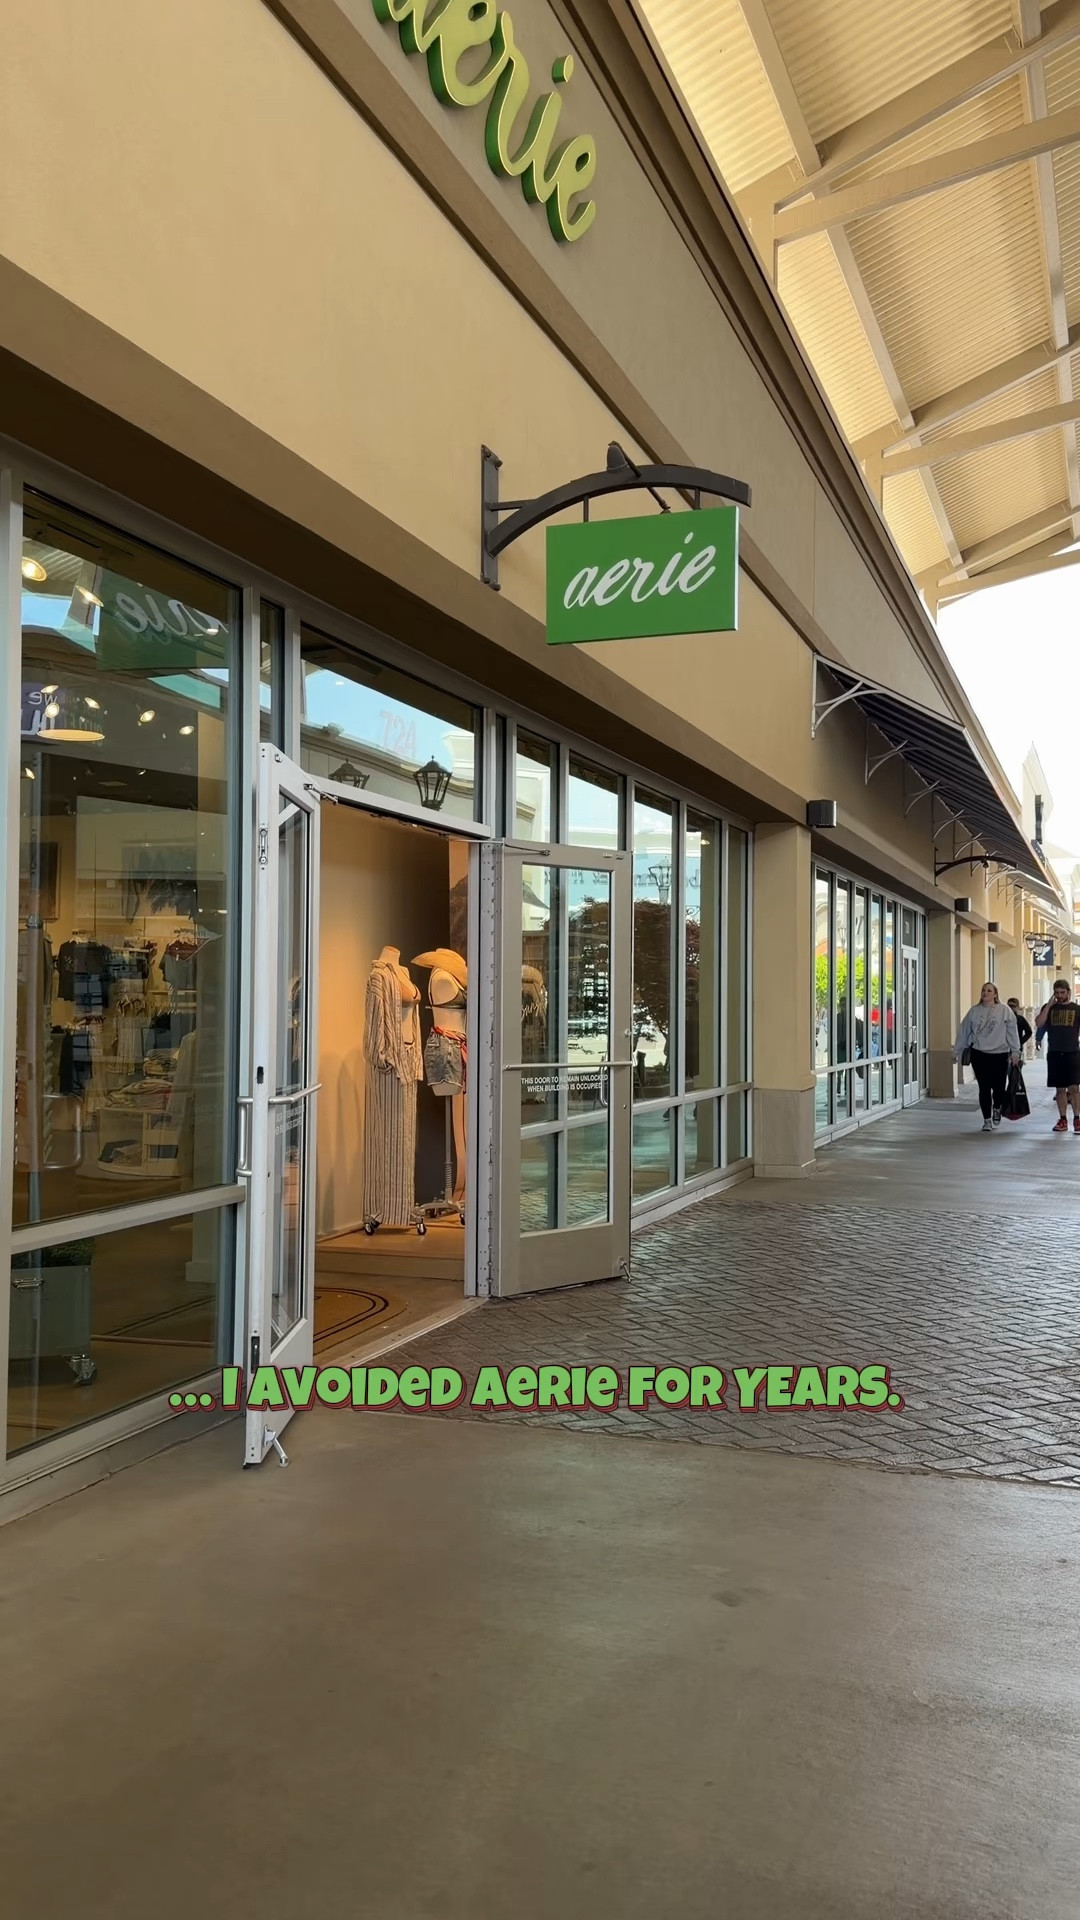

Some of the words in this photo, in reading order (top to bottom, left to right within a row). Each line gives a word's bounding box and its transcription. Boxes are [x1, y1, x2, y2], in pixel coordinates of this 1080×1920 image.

[563, 531, 717, 610] aerie
[534, 1076, 551, 1084] DOOR
[559, 1075, 580, 1083] REMAIN
[580, 1074, 608, 1082] UNLOCKED
[527, 1085, 544, 1093] WHEN
[544, 1084, 569, 1092] BUILDING
[576, 1082, 602, 1090] OCCUPIED
